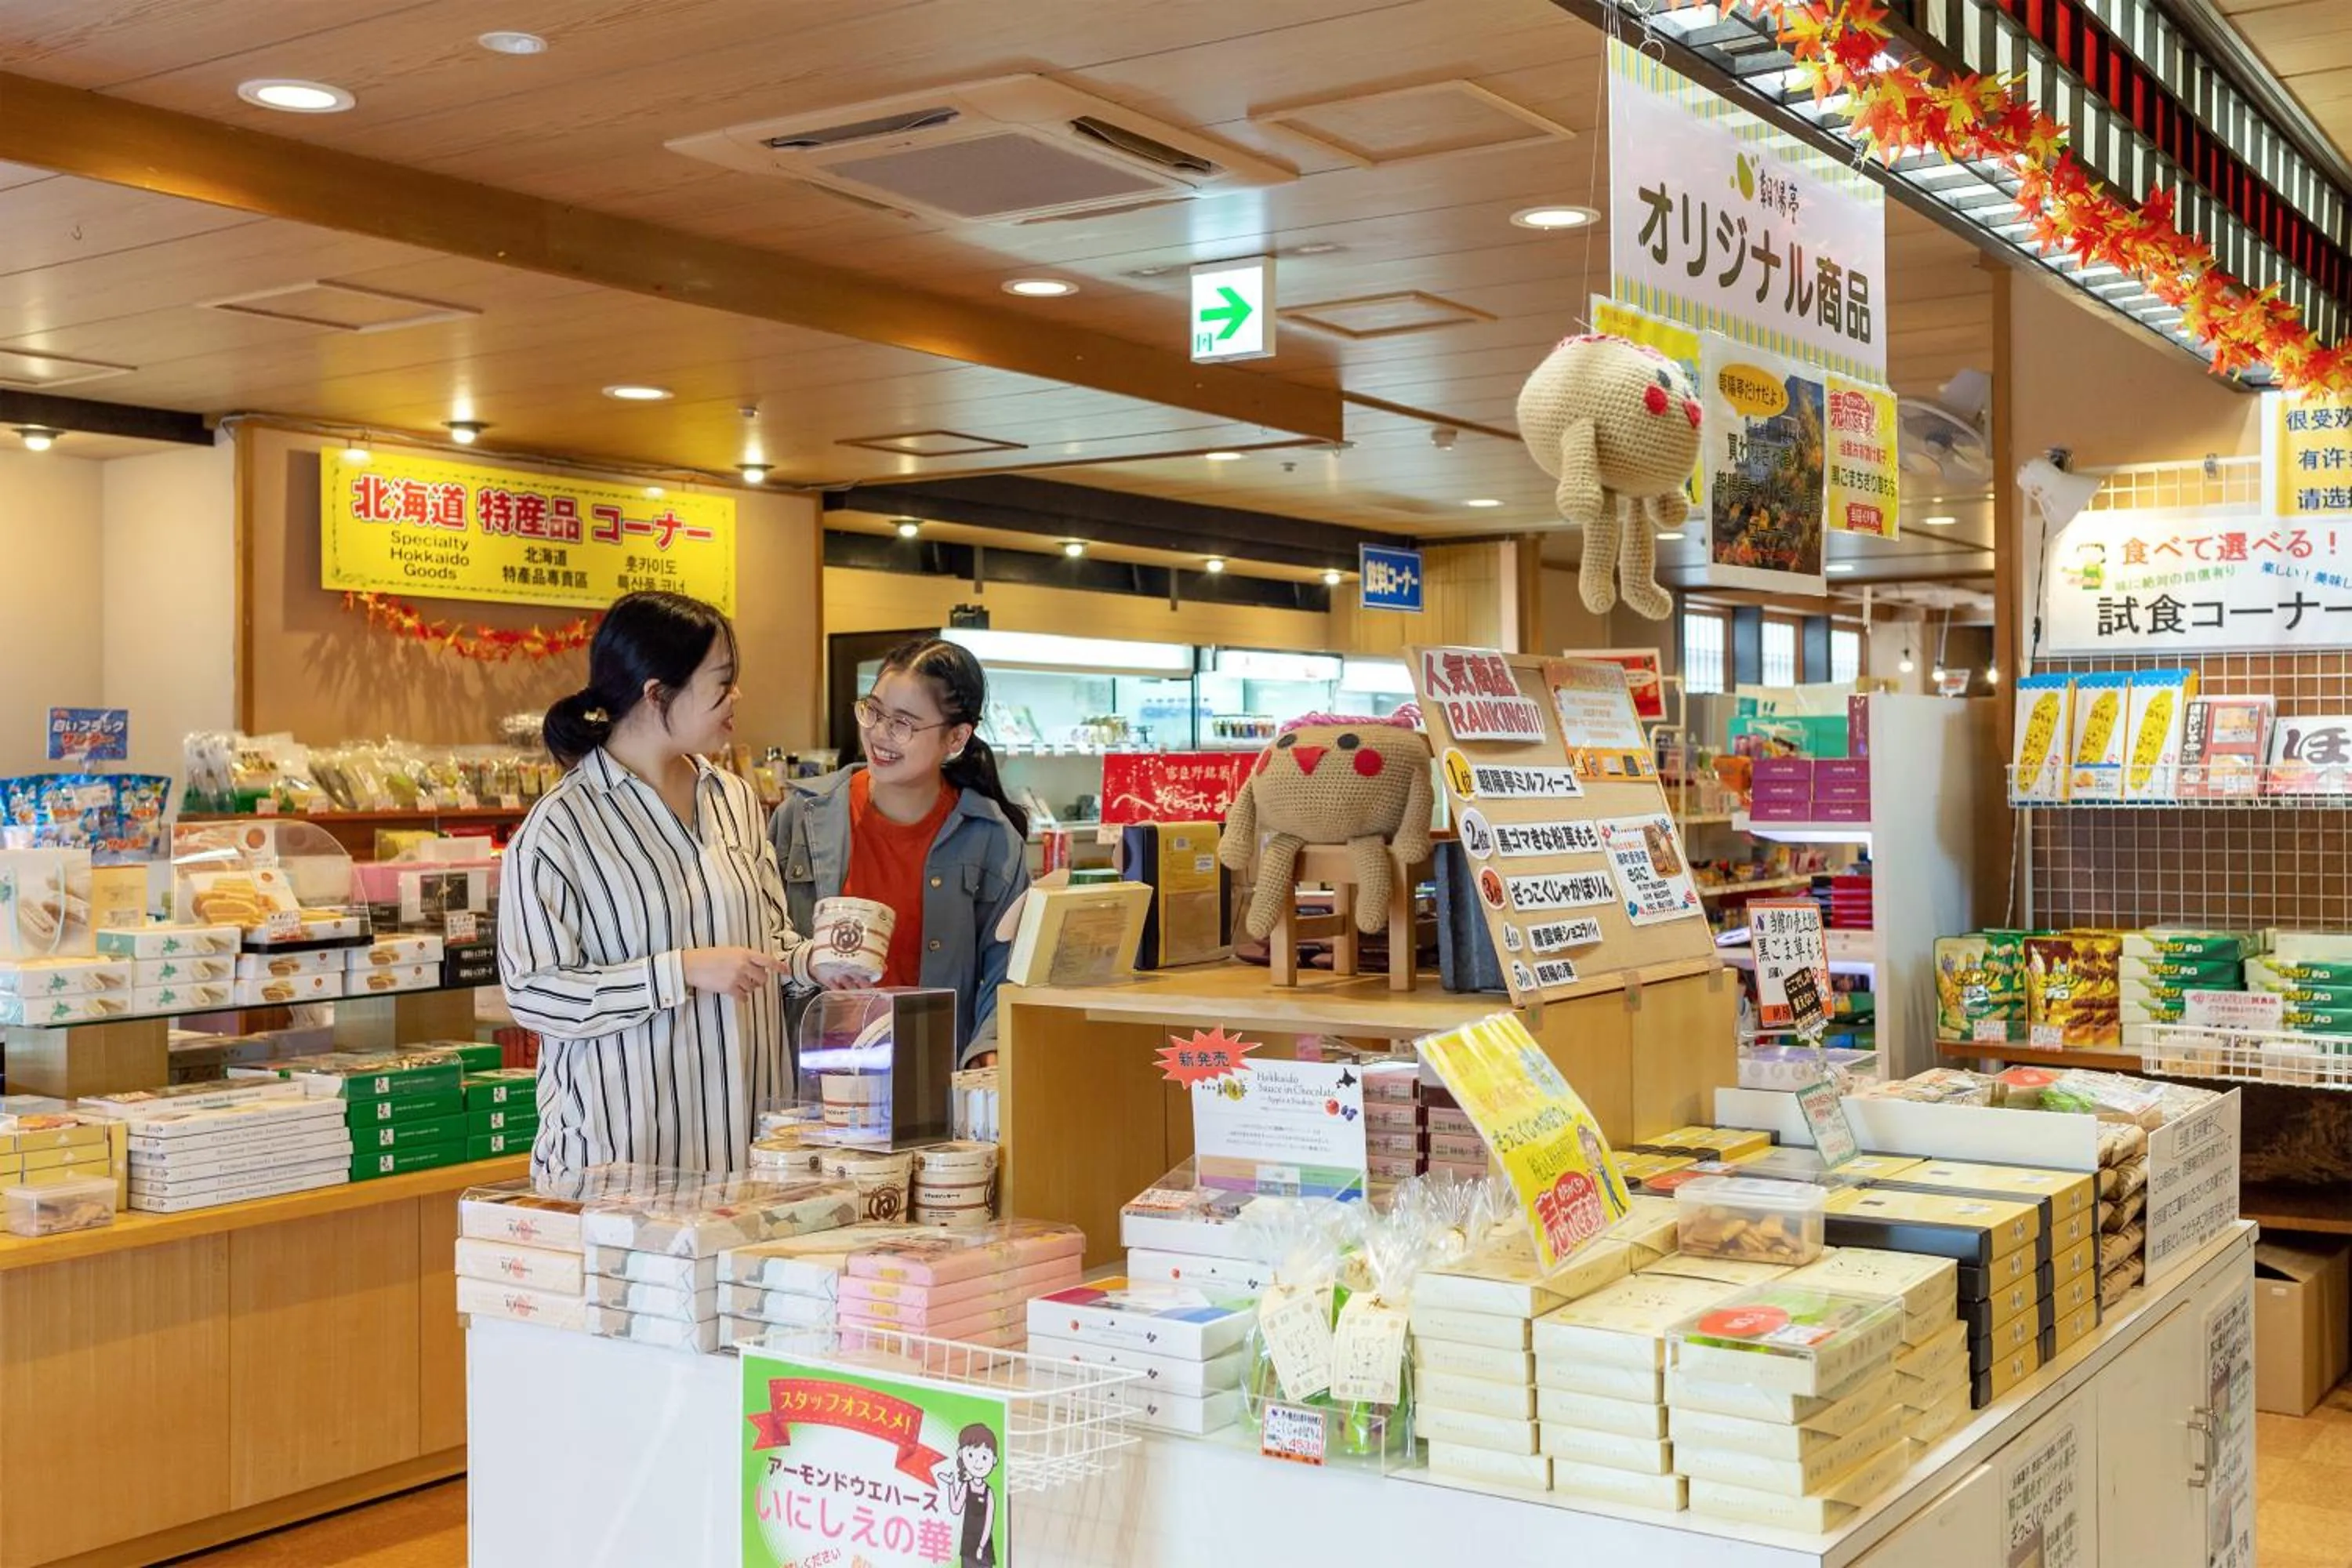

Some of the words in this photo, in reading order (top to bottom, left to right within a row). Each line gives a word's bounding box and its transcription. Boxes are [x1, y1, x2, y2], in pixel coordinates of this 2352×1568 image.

[1638, 183, 1871, 344] オリジナル商品
[2298, 447, 2352, 470] 有许
[2297, 486, 2352, 510] 请选
[350, 474, 469, 532] 北海道
[477, 488, 583, 543] 特産品
[591, 503, 715, 551] コーナー
[390, 530, 470, 552] Specialty
[2122, 528, 2338, 566] 食べて選べる！
[390, 547, 470, 568] Hokkaido
[524, 546, 567, 567] 北海道
[403, 564, 458, 581] Goods
[2097, 590, 2352, 637] 試食コーナー
[1425, 652, 1518, 698] 人気商品
[1497, 826, 1598, 852] 黒ゴマきな粉草もち
[1178, 1051, 1230, 1067] 新発売
[1294, 1085, 1337, 1098] Chocolate
[768, 1456, 939, 1513] アーモンドウエハース
[756, 1484, 953, 1565] いにしえの華
